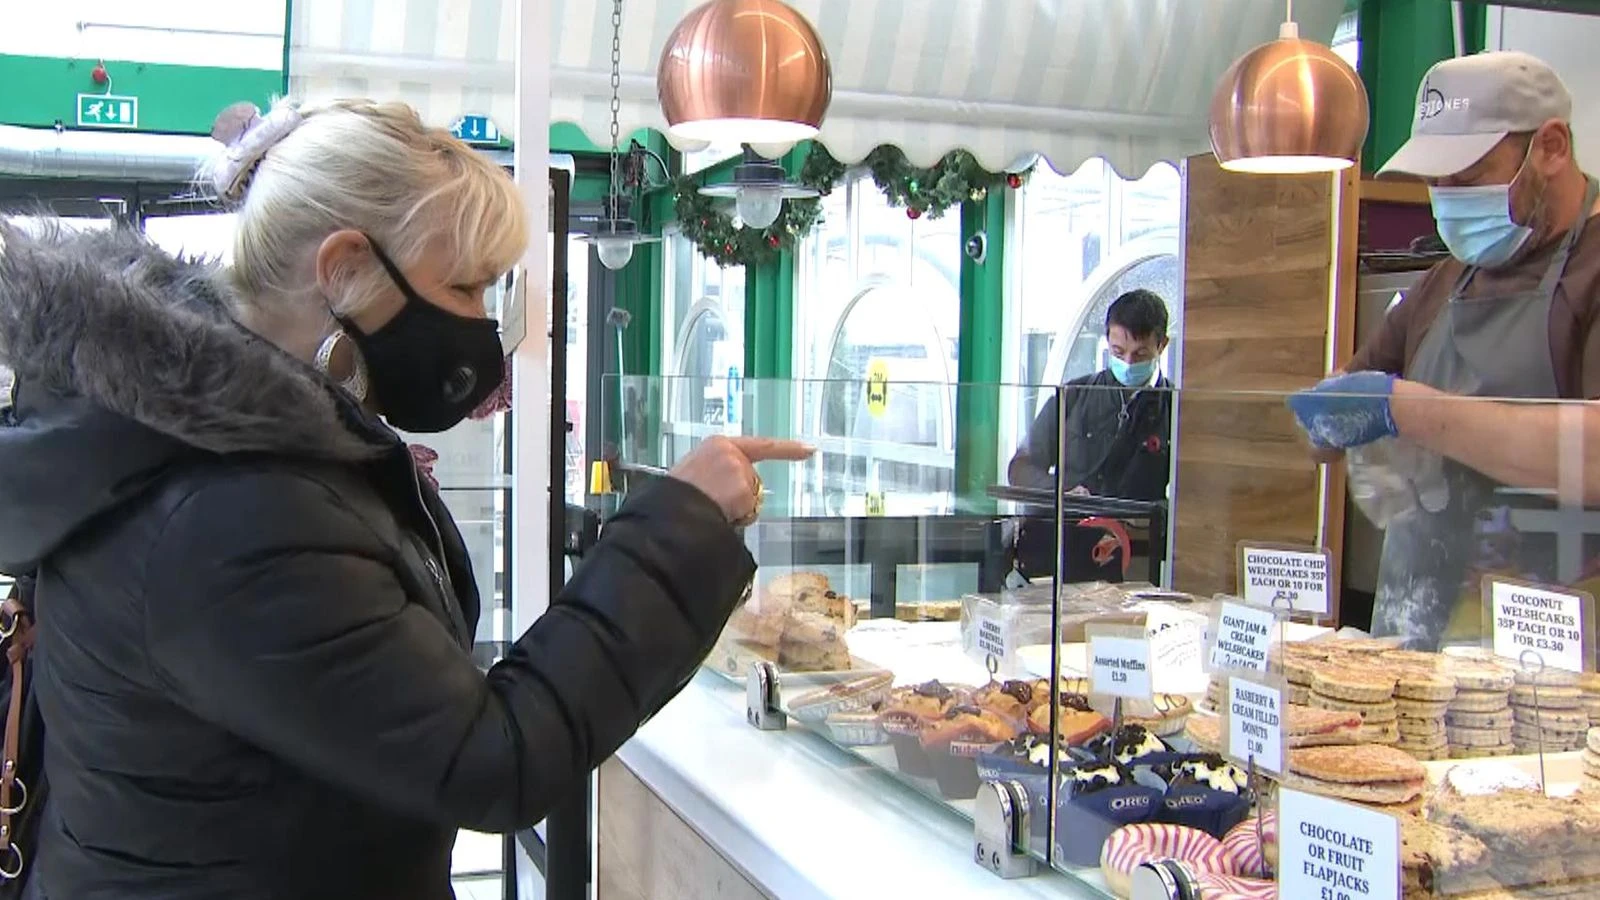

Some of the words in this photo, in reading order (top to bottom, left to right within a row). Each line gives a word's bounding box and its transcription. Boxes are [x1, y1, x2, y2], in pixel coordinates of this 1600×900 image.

[1247, 555, 1303, 567] CHOCOLATE
[1304, 560, 1326, 569] CHIP
[1247, 566, 1309, 579] WELSHCAKES
[1310, 572, 1326, 580] 35P
[1251, 577, 1276, 587] EACH
[1278, 579, 1291, 588] OR
[1293, 581, 1303, 590] 10
[1304, 582, 1323, 592] FOR
[1511, 593, 1564, 611] COCONUT
[1501, 604, 1575, 626] WELSHCAKES
[1223, 615, 1245, 630] GIANT
[1245, 620, 1261, 634] JAM
[1261, 624, 1267, 636] &
[1497, 617, 1515, 630] 35P
[1517, 621, 1546, 636] EACH
[1549, 627, 1566, 639] OR
[1568, 630, 1580, 642] 10
[1230, 630, 1255, 645] CREAM
[1513, 633, 1534, 648] FOR
[1536, 638, 1564, 652] £3.30
[1217, 640, 1265, 661] WELSHCAKES
[1094, 655, 1120, 669] Assorted
[1120, 658, 1146, 671] Muffins
[1269, 697, 1275, 709] &
[1232, 703, 1254, 720] CREAM
[1255, 708, 1279, 727] FILLED
[1242, 720, 1268, 740] DONUTS
[1247, 739, 1263, 754] £1.00
[1110, 796, 1150, 810] OREO
[1300, 821, 1373, 855] CHOCOLATE
[1308, 843, 1325, 860] OR
[1328, 848, 1365, 872] FRUIT
[1303, 860, 1370, 894] FLAPJACKS
